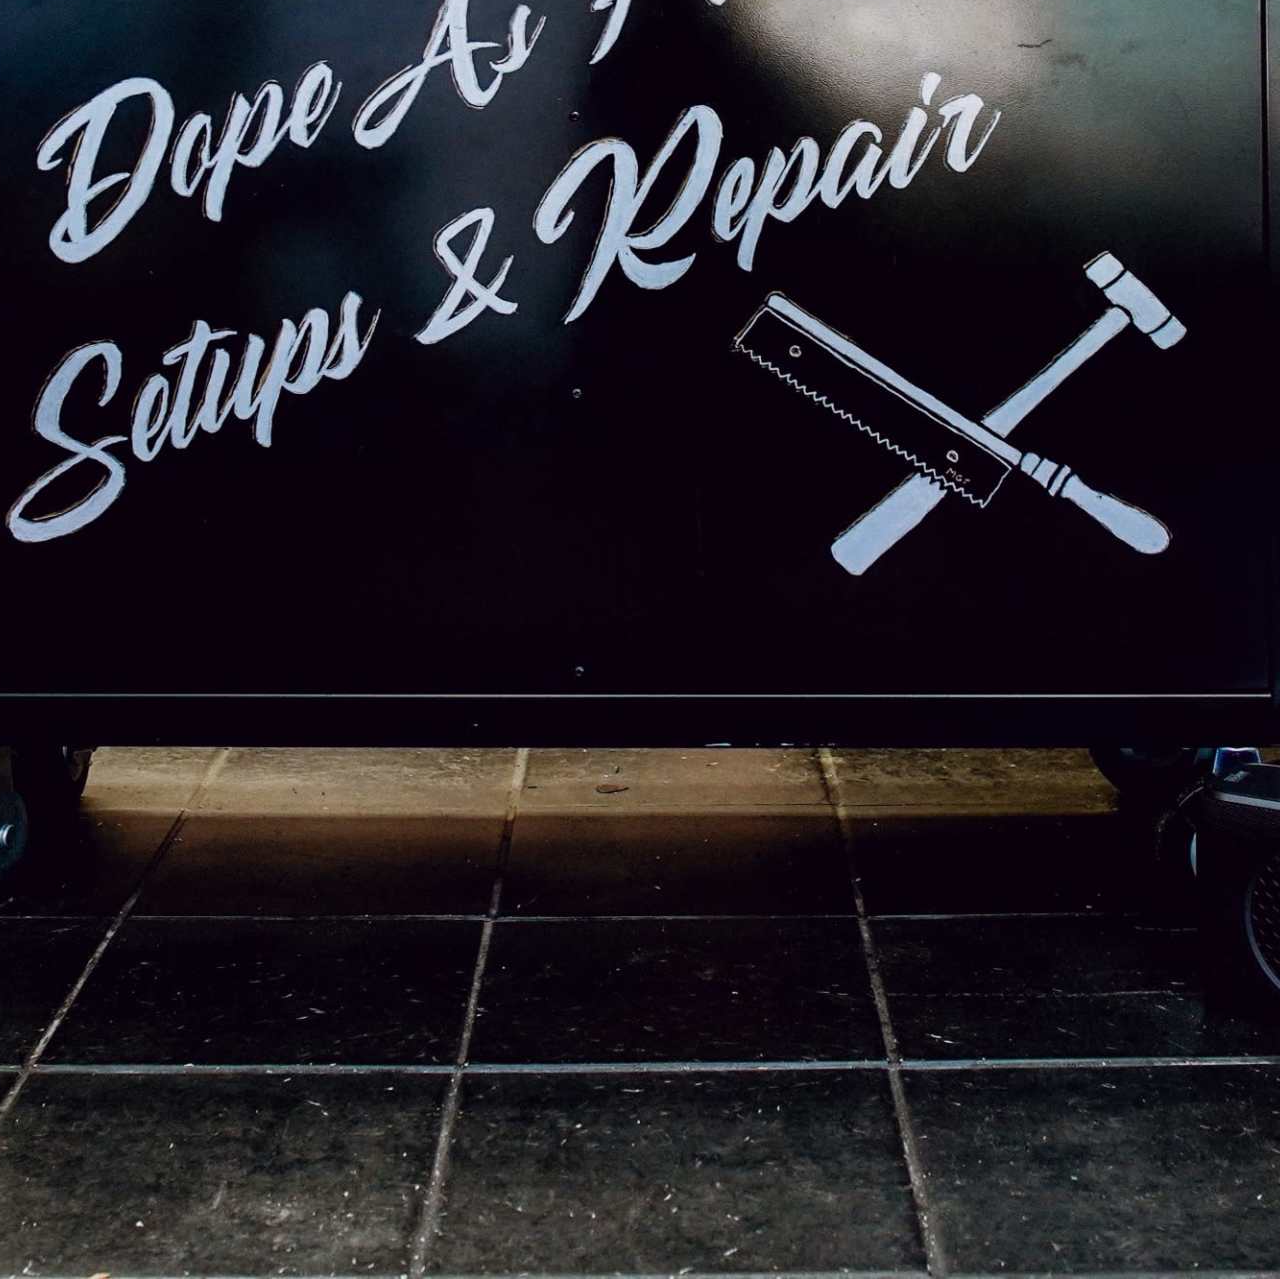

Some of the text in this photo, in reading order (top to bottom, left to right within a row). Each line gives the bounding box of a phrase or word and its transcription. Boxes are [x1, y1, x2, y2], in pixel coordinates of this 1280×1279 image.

[5, 70, 1001, 544] Setups & Repair
[35, 59, 341, 265] Dope
